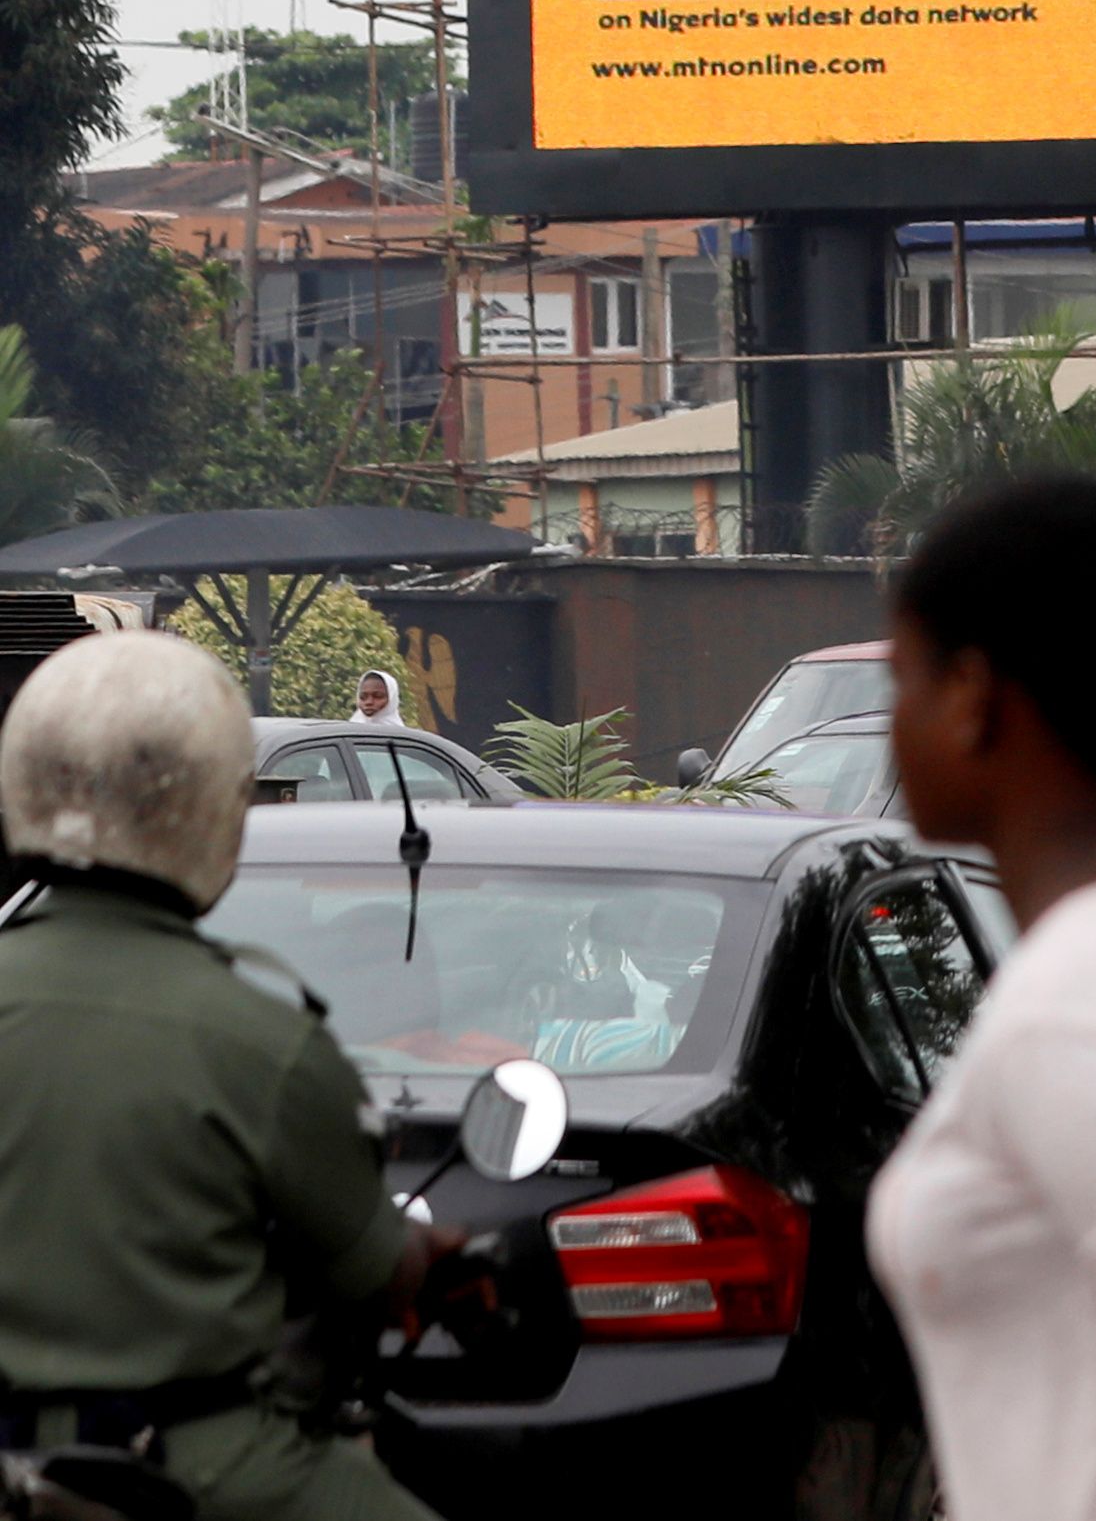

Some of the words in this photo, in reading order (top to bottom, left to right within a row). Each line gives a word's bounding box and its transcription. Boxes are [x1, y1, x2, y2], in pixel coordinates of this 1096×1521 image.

[598, 13, 632, 29] on
[639, 8, 759, 34] Nigeria's
[765, 5, 853, 27] widest
[859, 5, 920, 26] data
[927, 2, 1038, 23] network
[591, 54, 888, 78] www.mtnonline.com
